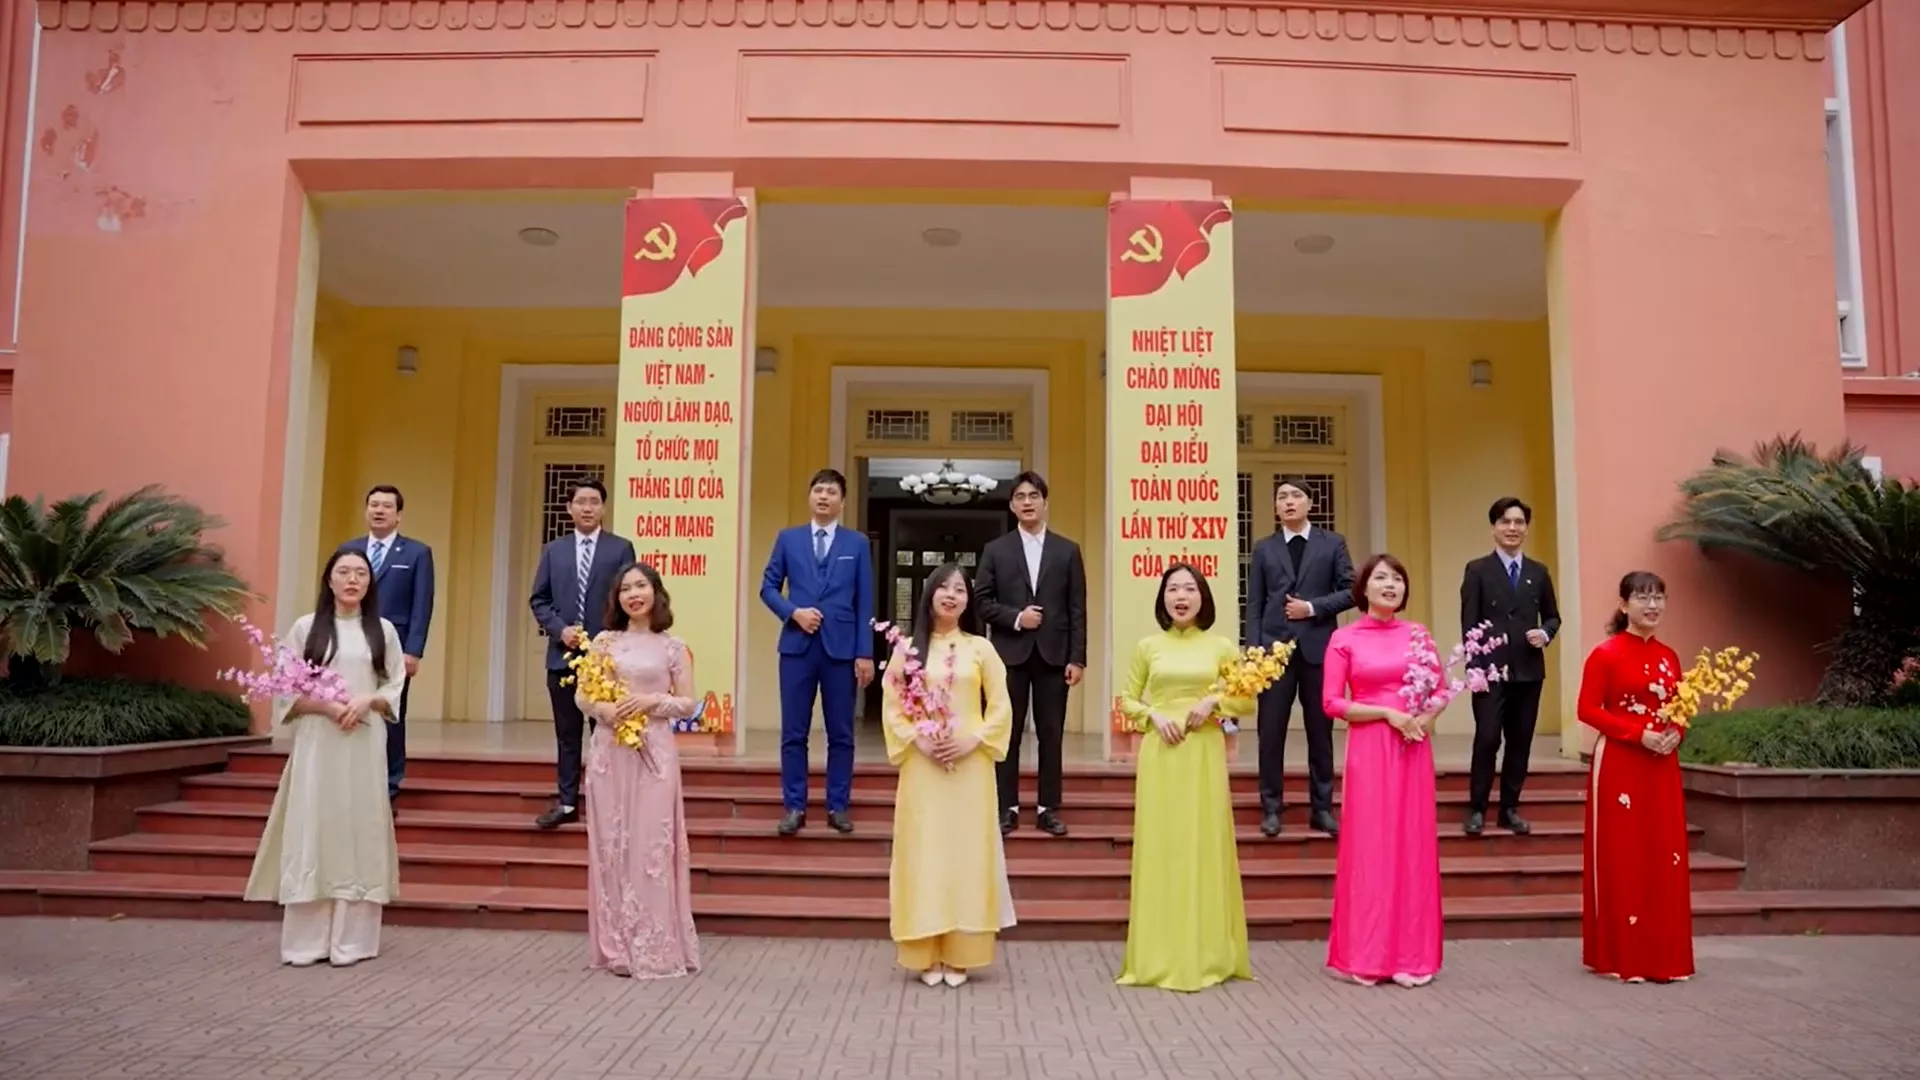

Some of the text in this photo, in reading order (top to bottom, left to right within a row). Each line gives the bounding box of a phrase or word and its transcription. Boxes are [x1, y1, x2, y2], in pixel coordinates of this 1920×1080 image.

[629, 319, 733, 352] ĐẢNG CỘNG SẢN
[1132, 326, 1213, 358] NHIỆT LIỆT
[645, 360, 672, 390] VIỆT
[675, 364, 705, 384] NAM
[1126, 362, 1220, 390] CHÀO MỪNG
[624, 396, 733, 427] NGƯỜI LÃNH ĐẠO,
[1145, 399, 1203, 432] ĐẠI HỘI
[636, 430, 719, 466] TỔ CHỨC MỌI
[1140, 432, 1208, 468] ĐẠI BIỂU
[628, 468, 725, 504] THẮNG LỢI CỦA
[1130, 471, 1219, 504] TOÀN QUỐC
[636, 510, 714, 542] CÁCH MẠNG
[1157, 512, 1188, 540] THỨ
[1191, 516, 1228, 540] XIV
[671, 554, 706, 576] NAM!
[1132, 546, 1163, 577] CỦA
